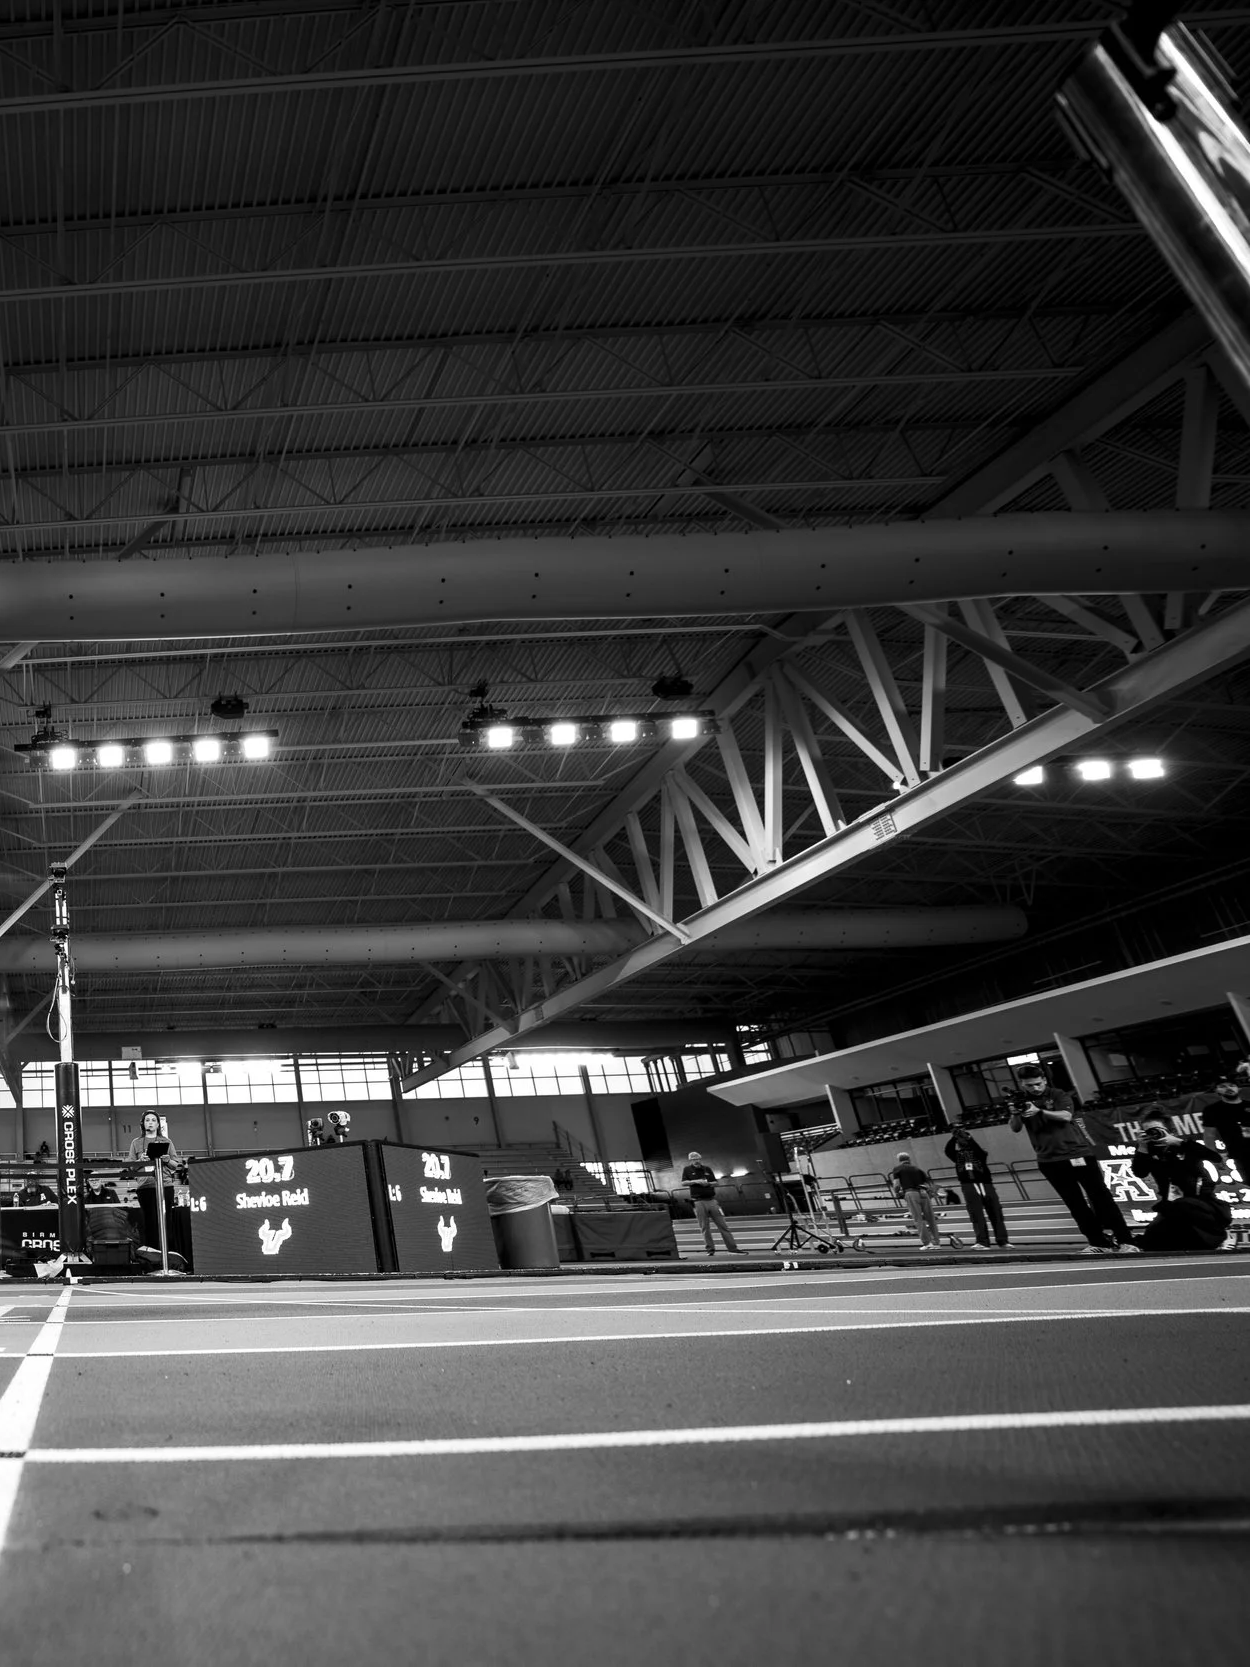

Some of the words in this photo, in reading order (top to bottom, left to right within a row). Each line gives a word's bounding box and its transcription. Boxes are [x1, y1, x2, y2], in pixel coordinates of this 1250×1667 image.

[122, 1124, 132, 1133] 11
[245, 1155, 295, 1184] 20.7
[281, 1188, 310, 1206] Reid
